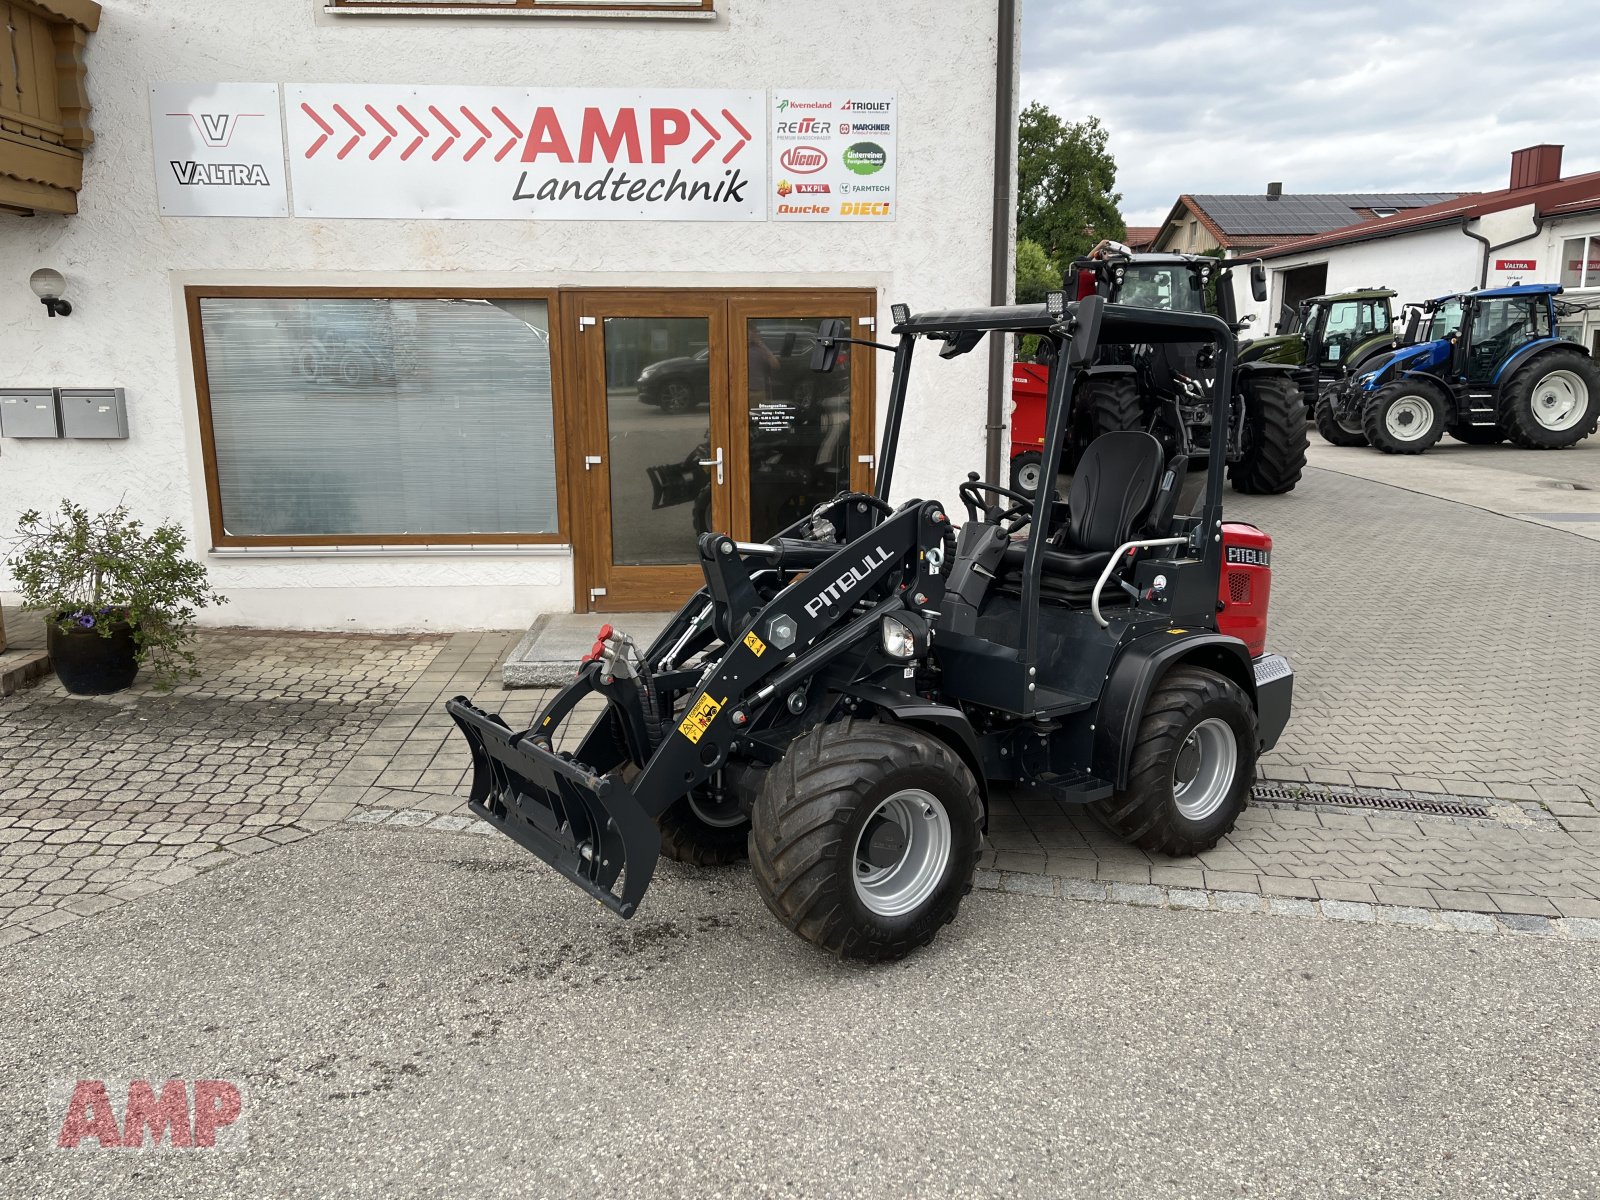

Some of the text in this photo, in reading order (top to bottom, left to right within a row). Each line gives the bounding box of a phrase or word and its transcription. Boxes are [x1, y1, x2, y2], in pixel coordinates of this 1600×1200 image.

[790, 101, 832, 109] Kverneland
[851, 102, 891, 110] TRIOLIET
[777, 117, 831, 133] REITER
[520, 106, 691, 164] AMP
[787, 149, 822, 166] Vicon
[170, 160, 270, 186] VALTRA
[512, 167, 749, 203] Landtechnik
[800, 184, 825, 193] AKPIL
[778, 204, 830, 214] Quicke
[840, 202, 890, 216] DIECI
[1503, 261, 1529, 269] VALTRA
[1228, 547, 1269, 566] PITBULL
[803, 545, 894, 619] PITBULL
